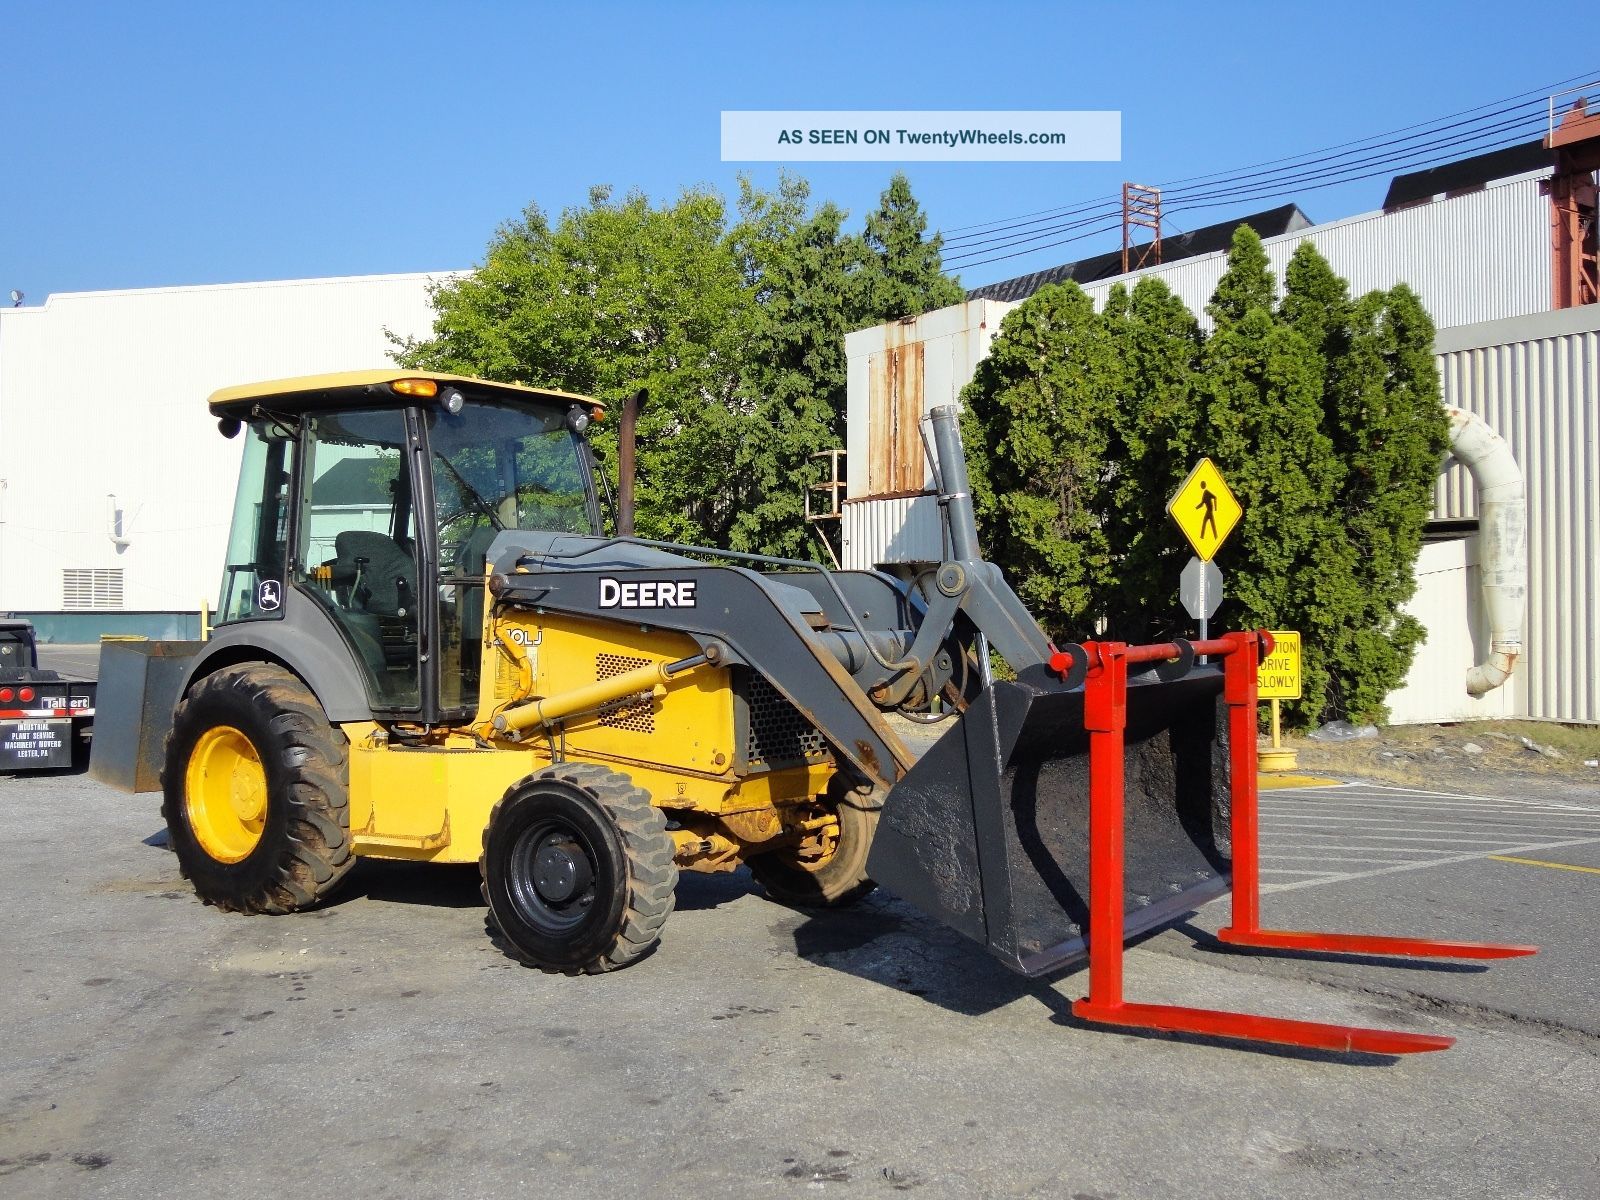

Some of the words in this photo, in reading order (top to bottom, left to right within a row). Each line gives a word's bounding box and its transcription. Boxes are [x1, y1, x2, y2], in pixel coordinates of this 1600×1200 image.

[599, 578, 696, 608] DEERE
[1261, 659, 1290, 671] DRIVE
[1257, 676, 1295, 688] SLOWLY
[17, 723, 49, 731] INDUSTRIAL
[11, 732, 31, 740] PLANT
[33, 731, 55, 740] SERVICE
[4, 741, 37, 749] MACHINERY
[41, 749, 48, 757] PA
